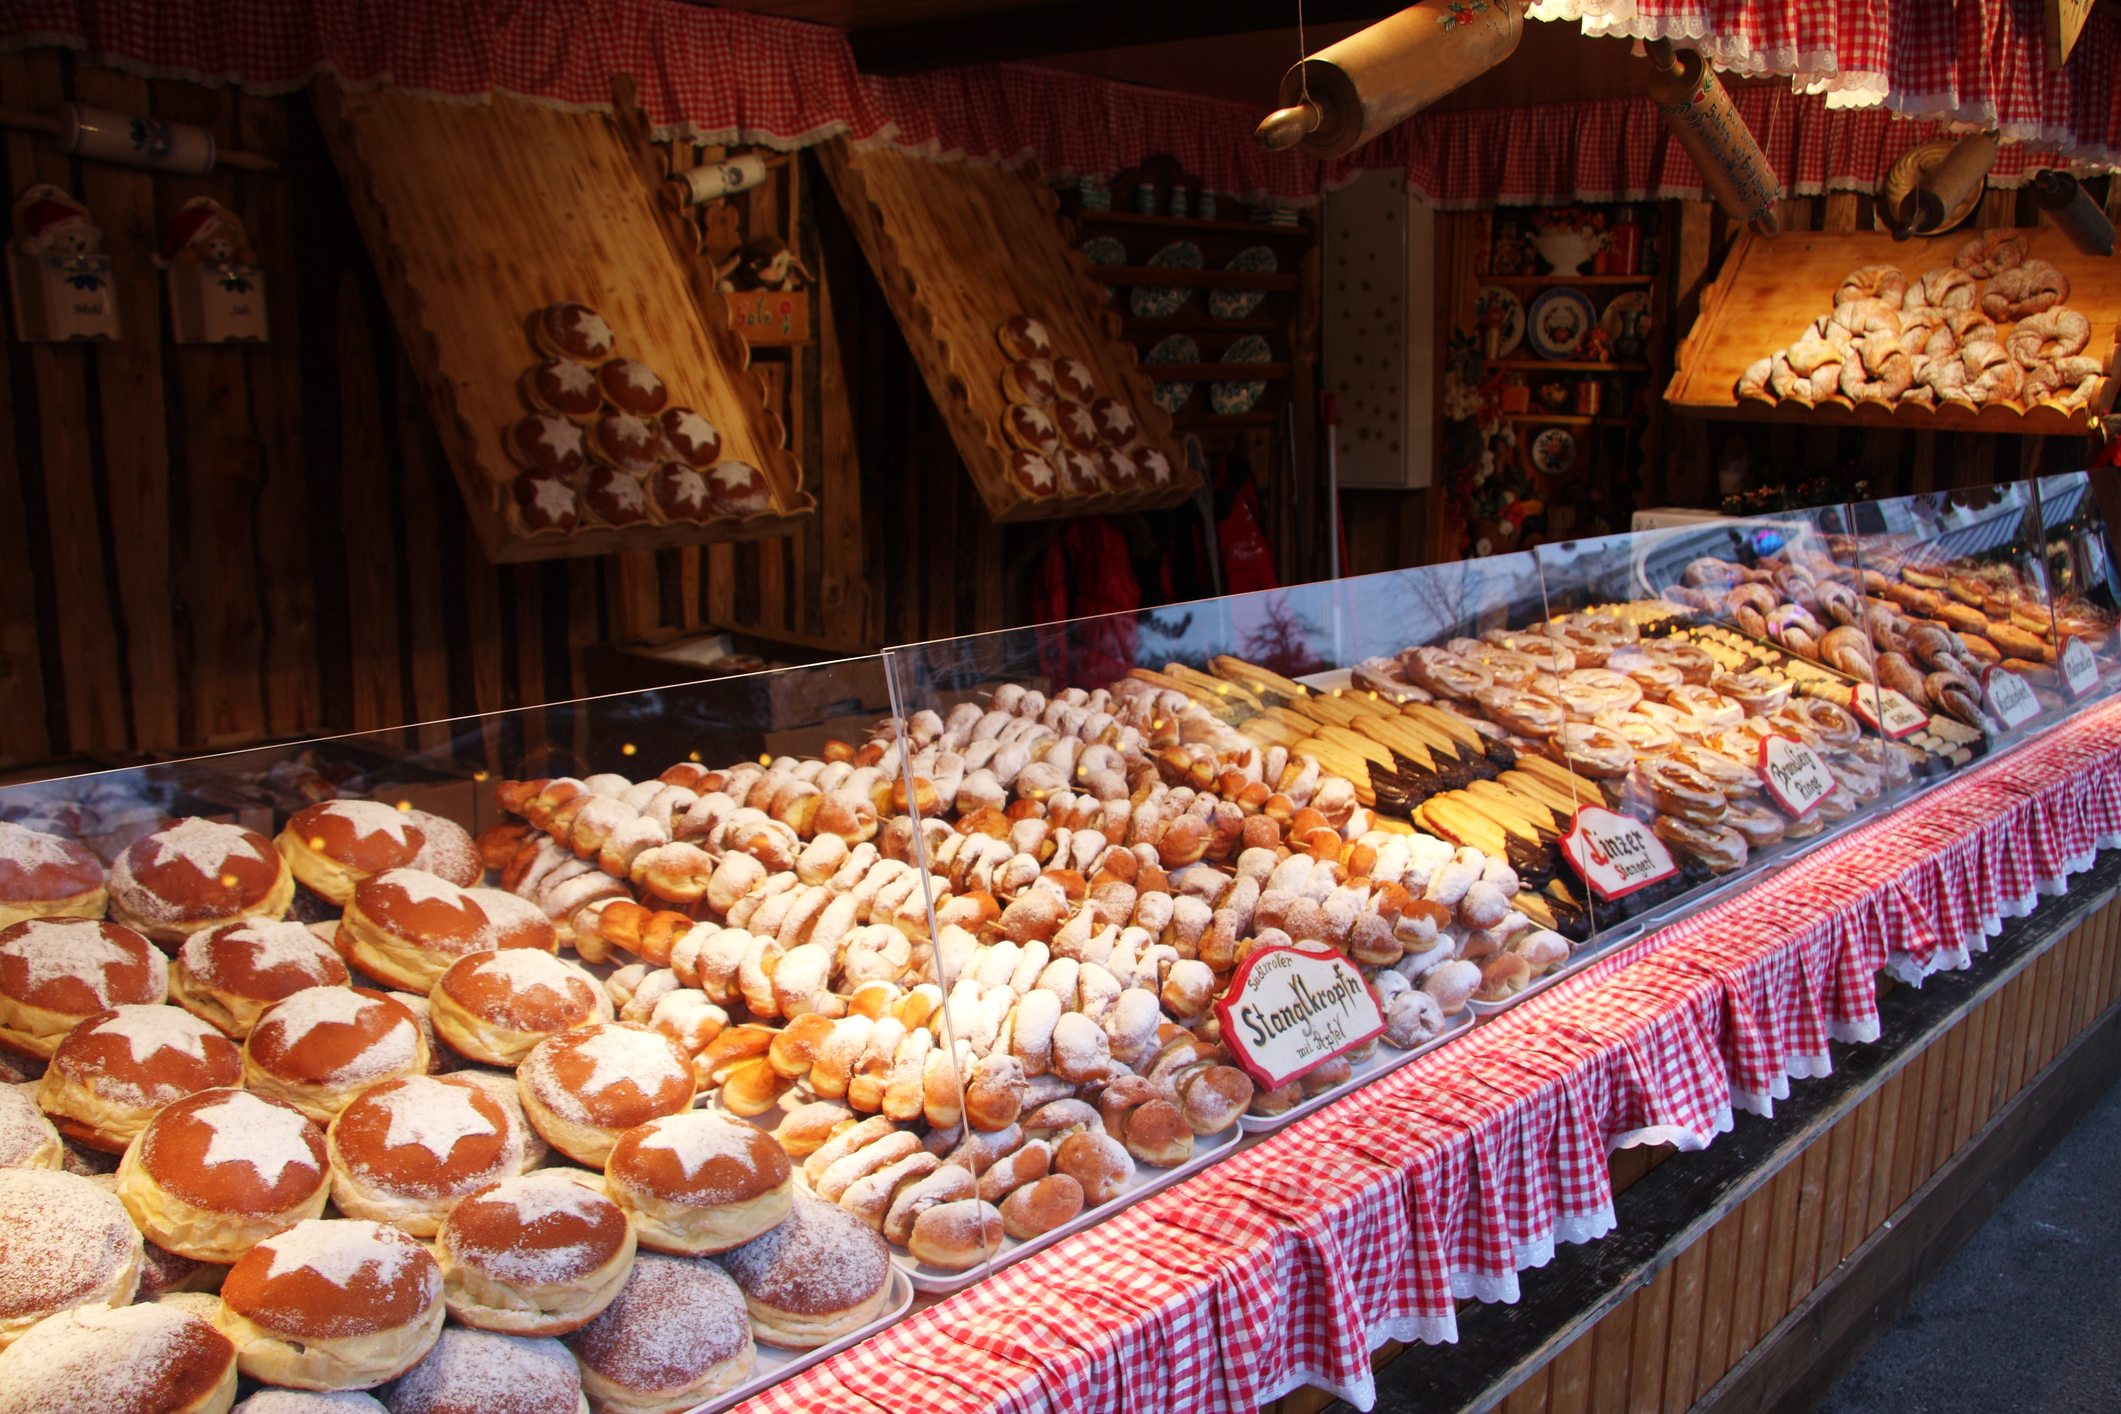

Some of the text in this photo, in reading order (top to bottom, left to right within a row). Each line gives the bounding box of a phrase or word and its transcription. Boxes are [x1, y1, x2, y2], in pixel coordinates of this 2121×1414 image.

[1580, 826, 1646, 867] Linzer
[1613, 850, 1657, 881] Stangerl
[1240, 962, 1362, 1048] Stanglkropfn
[1296, 1041, 1314, 1060] mit
